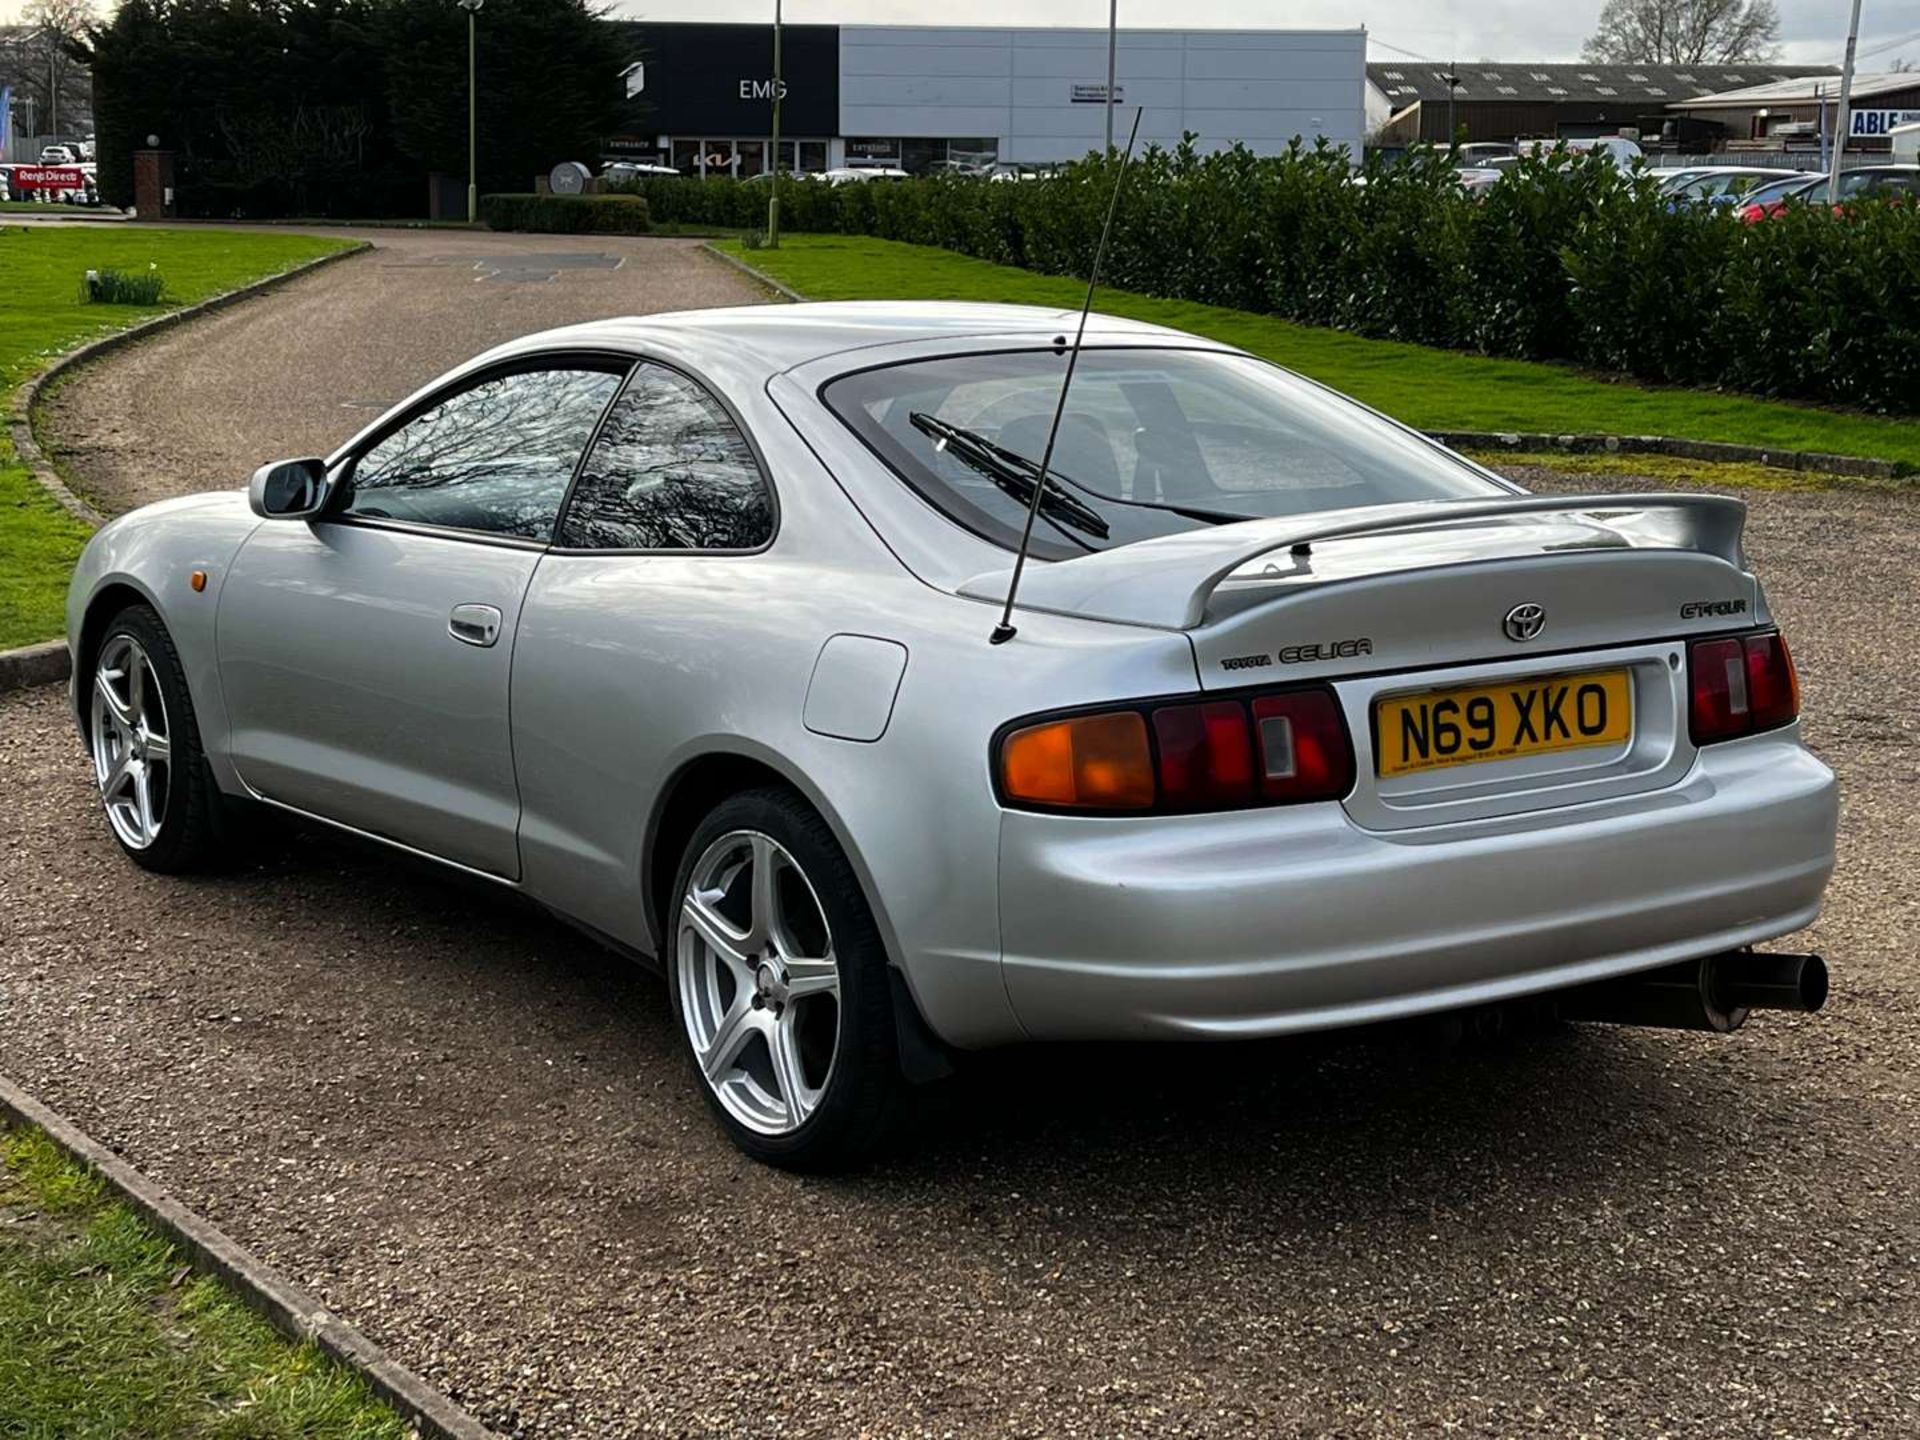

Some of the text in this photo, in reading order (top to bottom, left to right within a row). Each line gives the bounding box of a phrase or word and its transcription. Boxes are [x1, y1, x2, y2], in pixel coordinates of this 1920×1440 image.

[740, 79, 787, 98] EMG
[1852, 111, 1898, 134] ABLE
[1221, 638, 1373, 670] TOYOTA CELICA
[1401, 683, 1607, 762] N69 XKO
